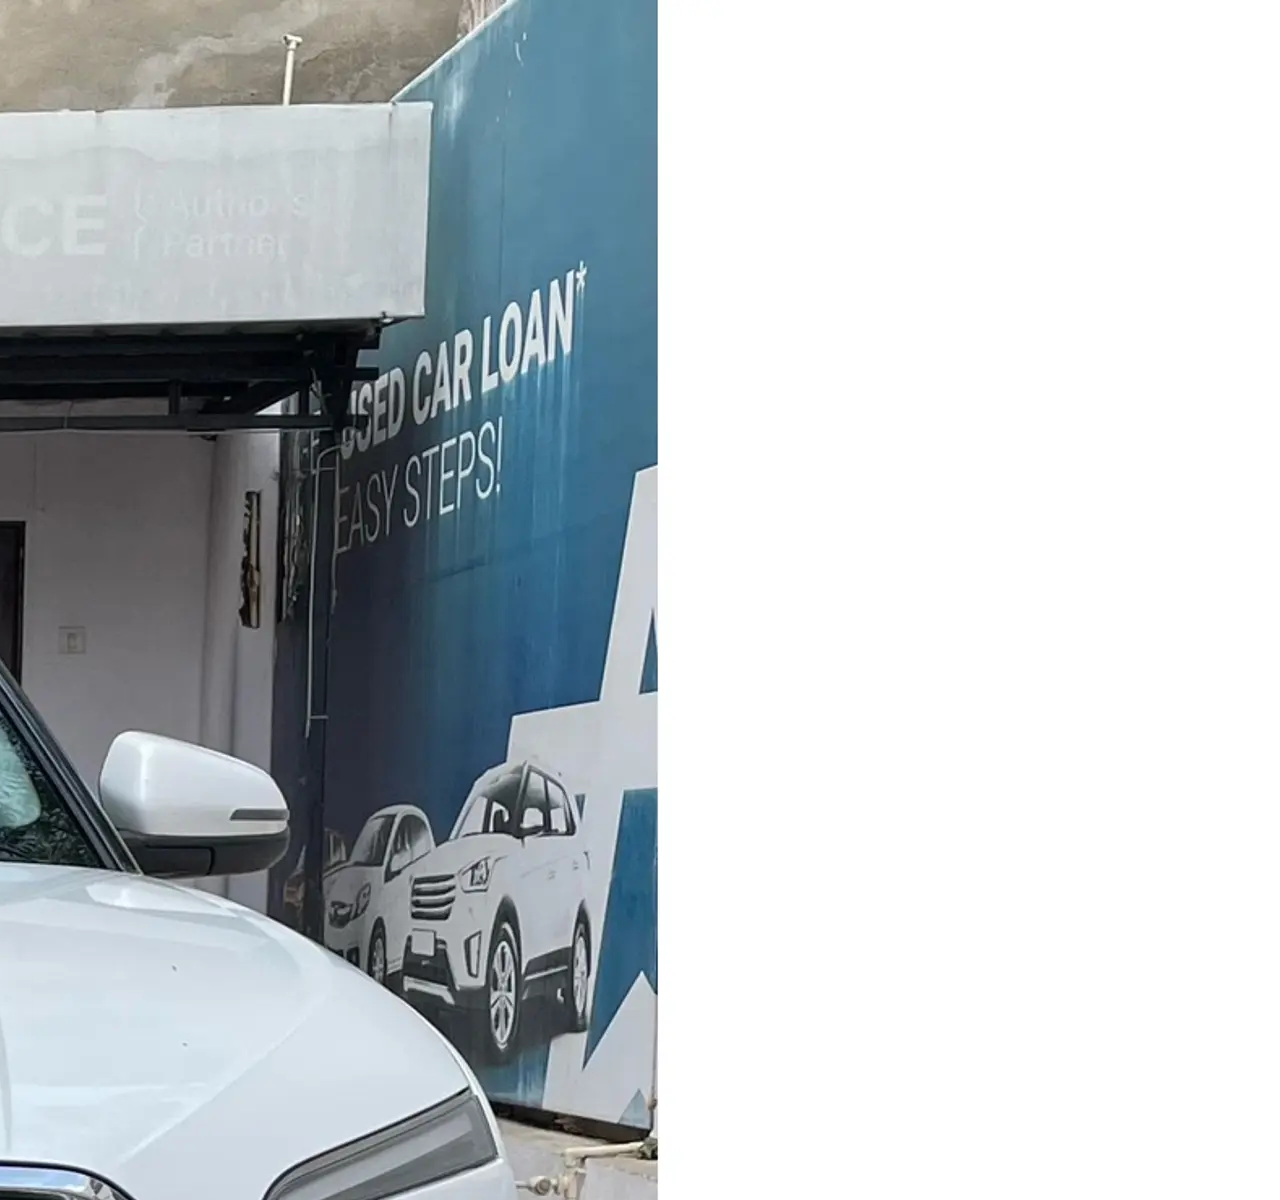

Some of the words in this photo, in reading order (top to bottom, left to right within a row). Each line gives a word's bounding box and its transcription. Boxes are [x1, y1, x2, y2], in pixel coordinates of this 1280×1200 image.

[412, 328, 474, 426] CAR
[333, 464, 399, 556] EASY
[403, 415, 504, 529] STEPS!
